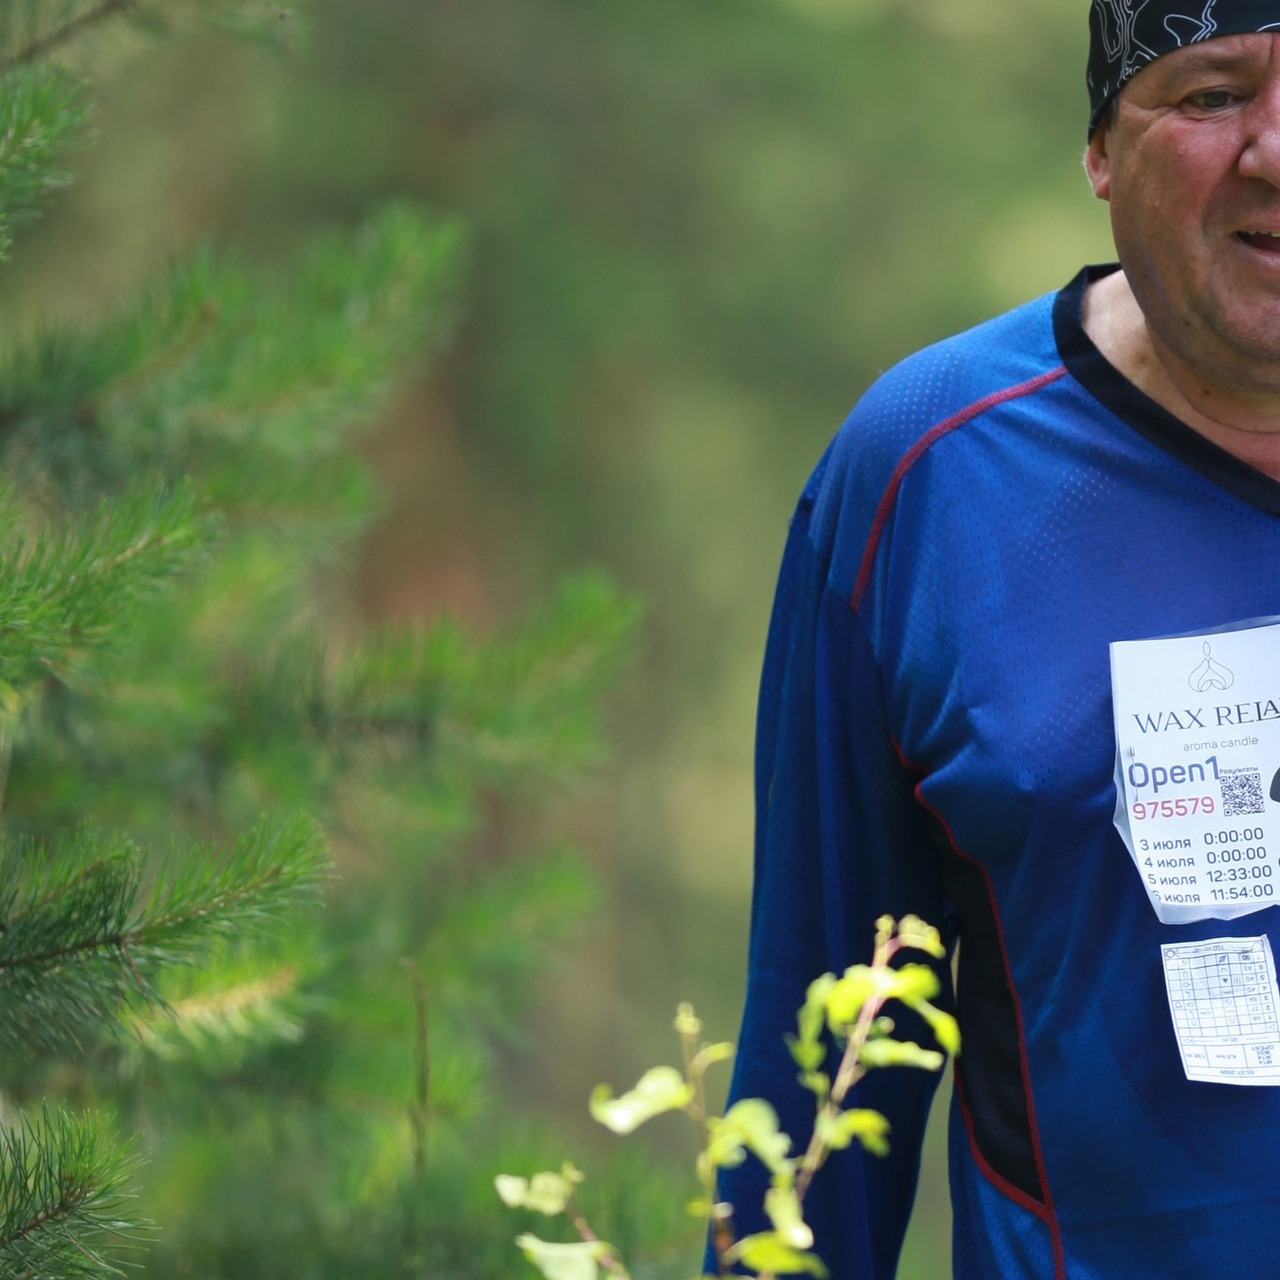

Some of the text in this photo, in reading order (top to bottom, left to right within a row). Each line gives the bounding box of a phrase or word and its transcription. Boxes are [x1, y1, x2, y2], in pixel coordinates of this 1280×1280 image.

[1132, 708, 1206, 734] WAX
[1183, 735, 1259, 752] aroma candle
[1128, 755, 1221, 794] Open1
[1132, 796, 1215, 821] 975579
[1139, 827, 1264, 851] 3 июля 0:00:00
[1144, 846, 1267, 868] 4 июля 0:00:00
[1148, 864, 1273, 886] 5 июля 12:33:00
[1165, 893, 1201, 903] июля
[1210, 883, 1274, 901] 11:54:00
